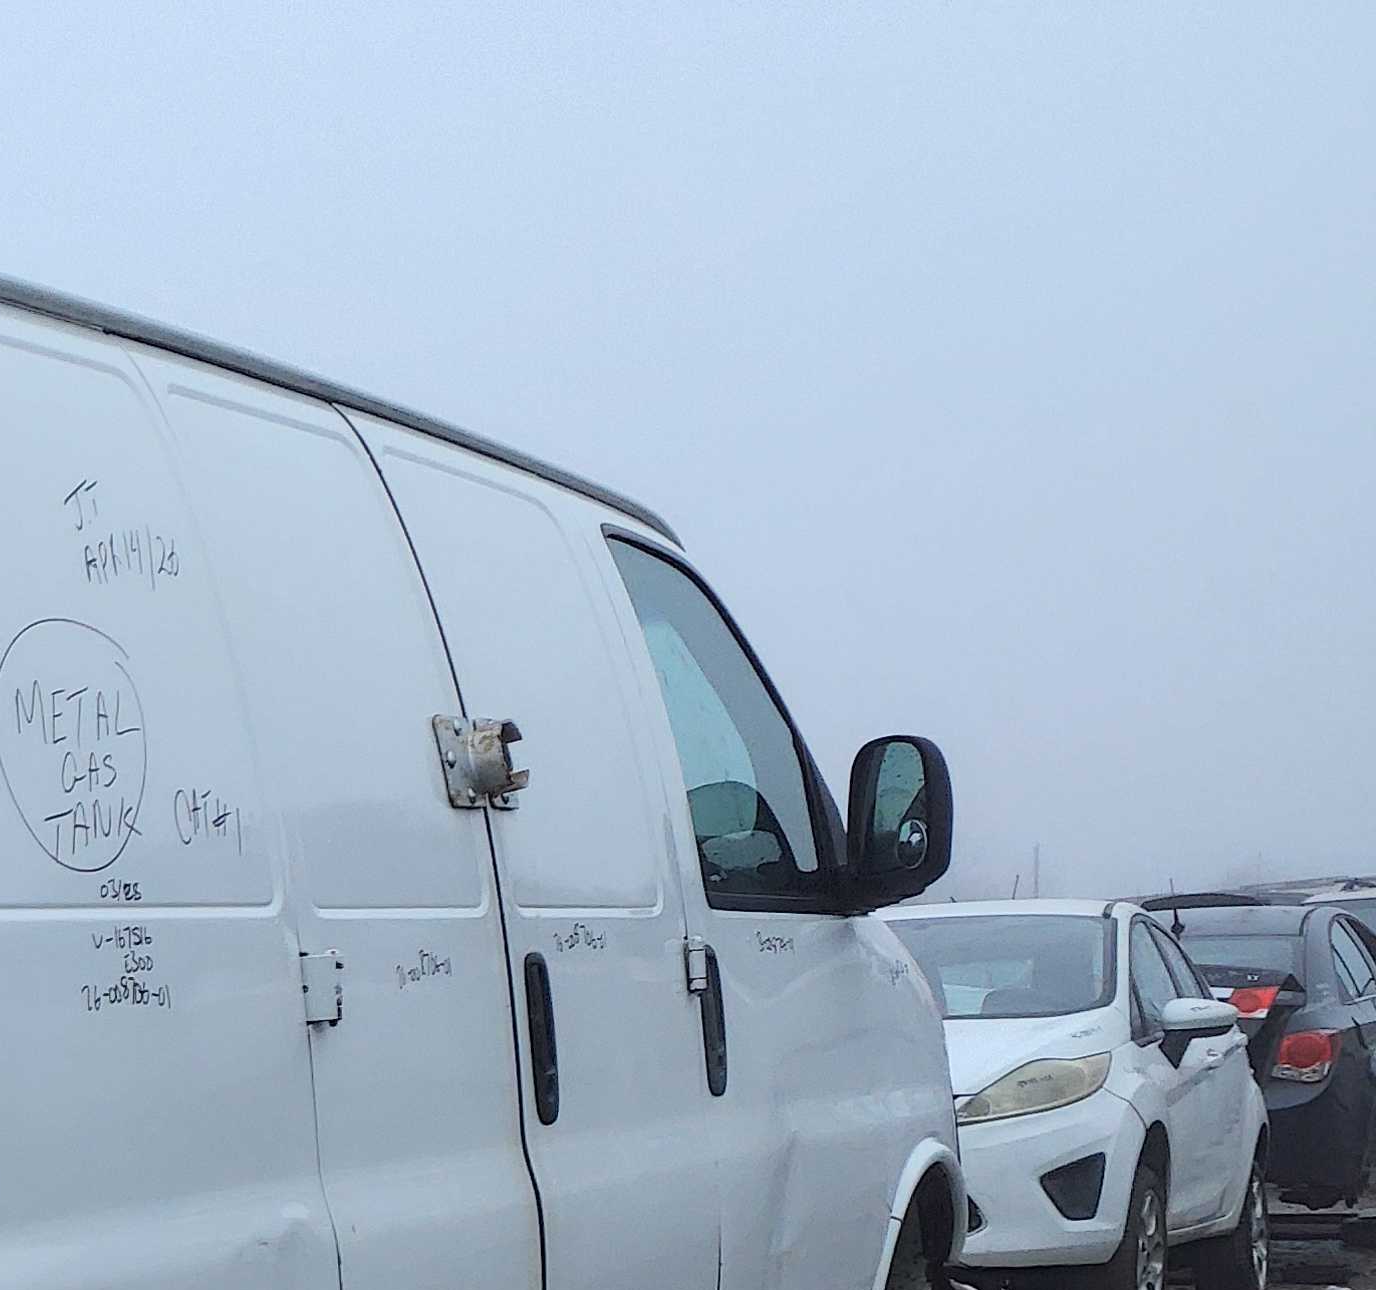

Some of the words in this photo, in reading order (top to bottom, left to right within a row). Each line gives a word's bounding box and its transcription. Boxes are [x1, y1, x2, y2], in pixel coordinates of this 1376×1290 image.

[15, 679, 141, 748] METAL
[61, 751, 118, 793] GAS
[44, 797, 143, 864] TANK
